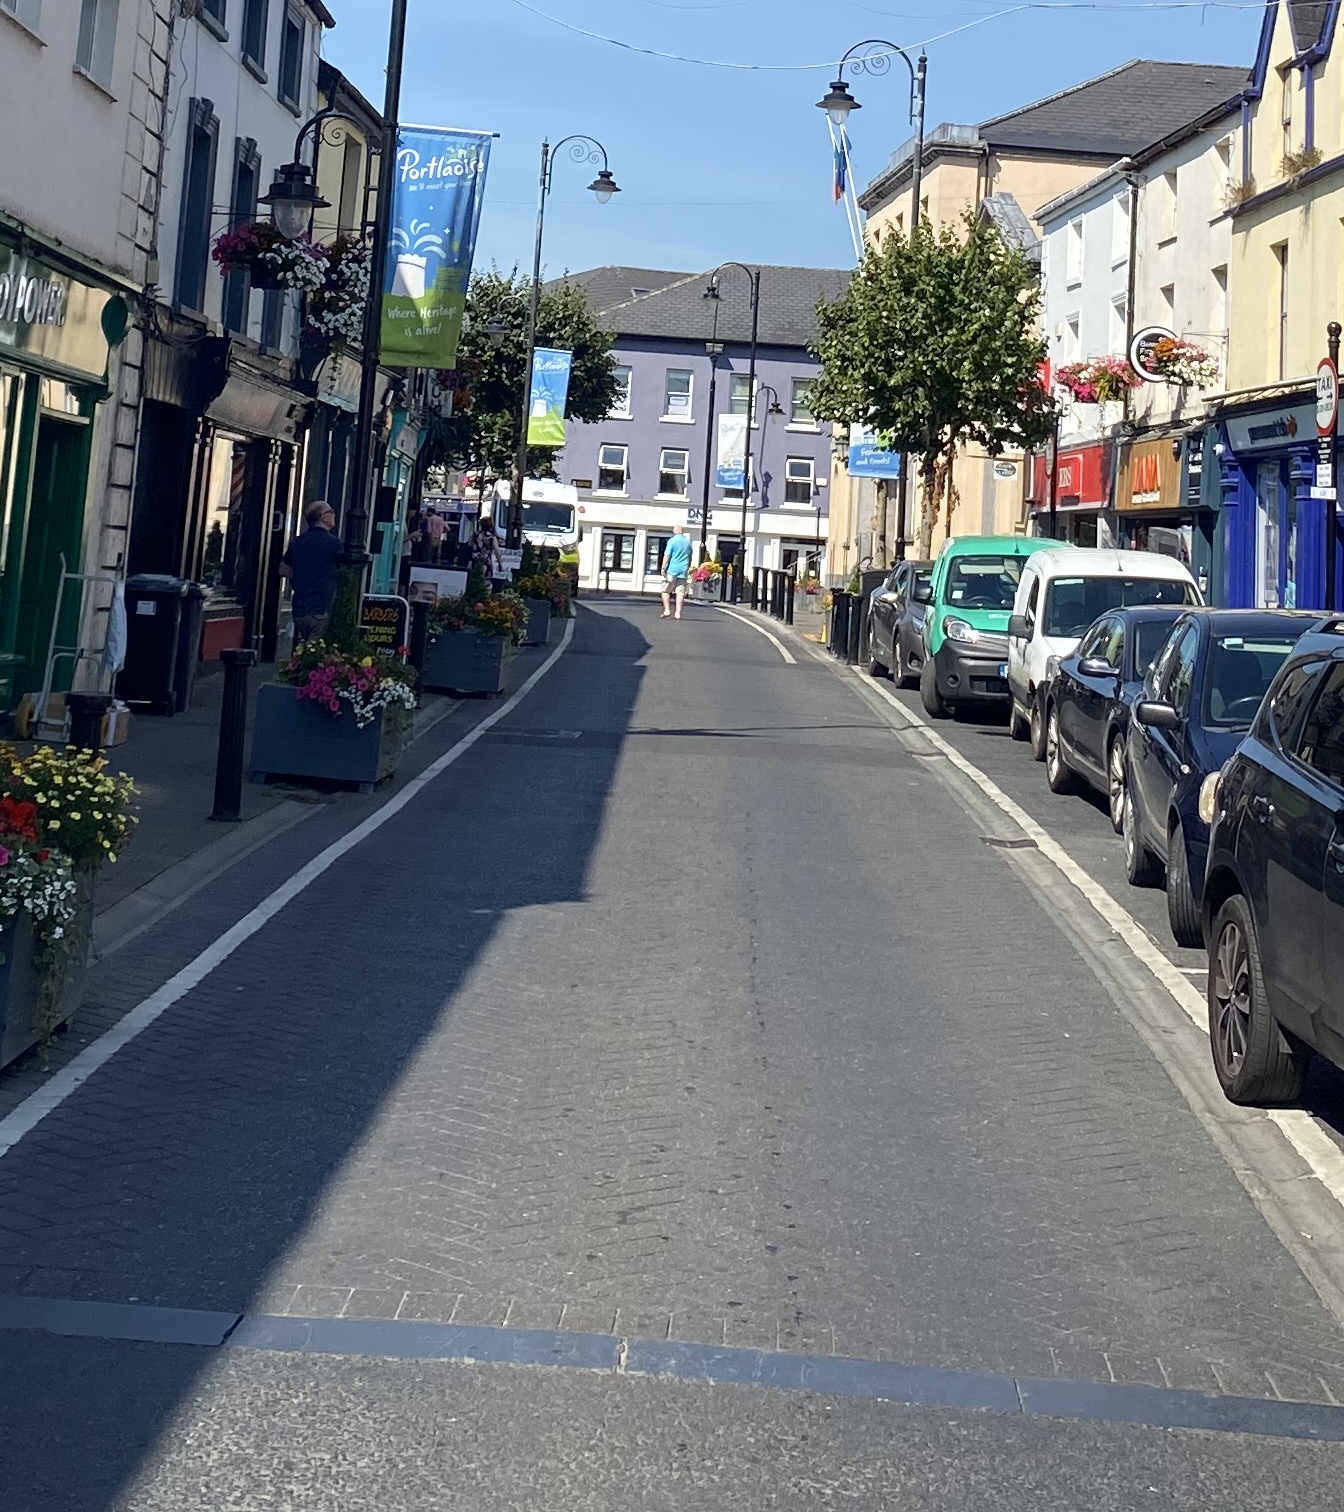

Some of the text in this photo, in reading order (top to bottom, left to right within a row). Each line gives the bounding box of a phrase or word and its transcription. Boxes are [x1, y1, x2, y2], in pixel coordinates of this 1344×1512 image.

[397, 149, 484, 182] Portlaoise
[387, 304, 457, 321] Where Heritage
[1317, 377, 1333, 394] TAXI
